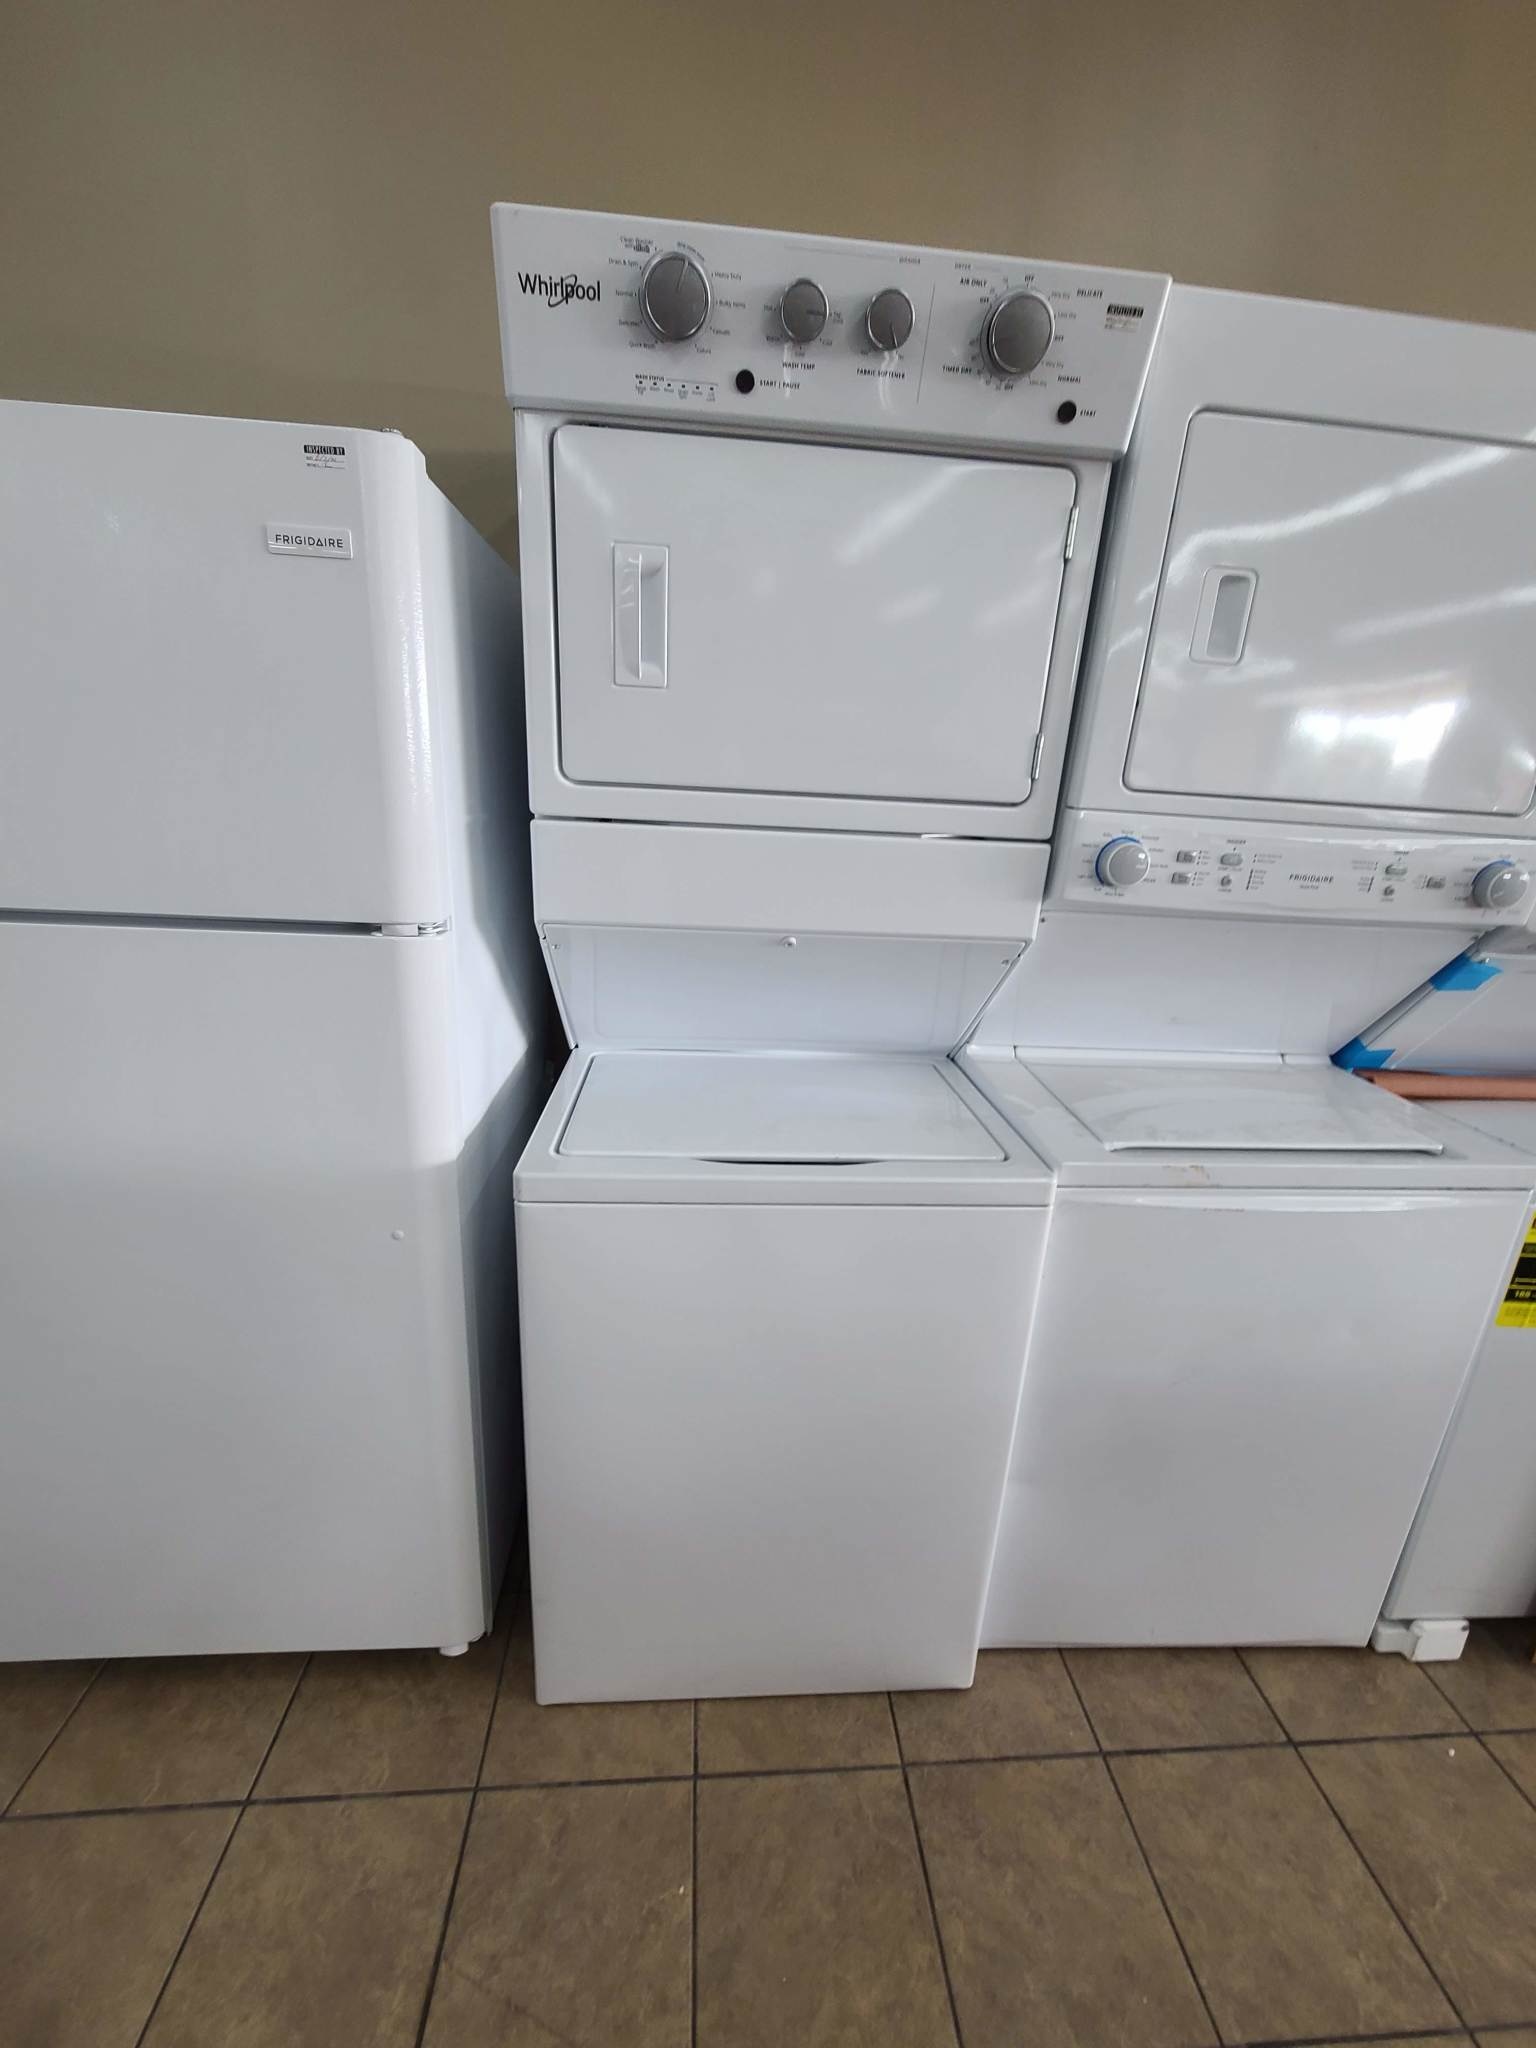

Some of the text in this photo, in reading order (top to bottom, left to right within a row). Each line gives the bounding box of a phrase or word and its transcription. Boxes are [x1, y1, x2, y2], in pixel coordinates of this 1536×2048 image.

[960, 278, 987, 288] AIR ONLY
[518, 271, 601, 307] Whirlpool
[1077, 289, 1104, 299] DELICATE
[782, 361, 816, 370] WASH TEMP
[942, 365, 960, 374] TIMED
[856, 368, 905, 379] FABRIC SOFTENER
[1057, 375, 1081, 383] NORMAL
[759, 379, 777, 387] START
[782, 382, 801, 390] PAUSE
[1080, 409, 1096, 417] START
[307, 445, 334, 454] INSPECTED
[275, 534, 344, 548] FRIGIDAIRE
[1289, 873, 1334, 884] FRIGIDAIRE
